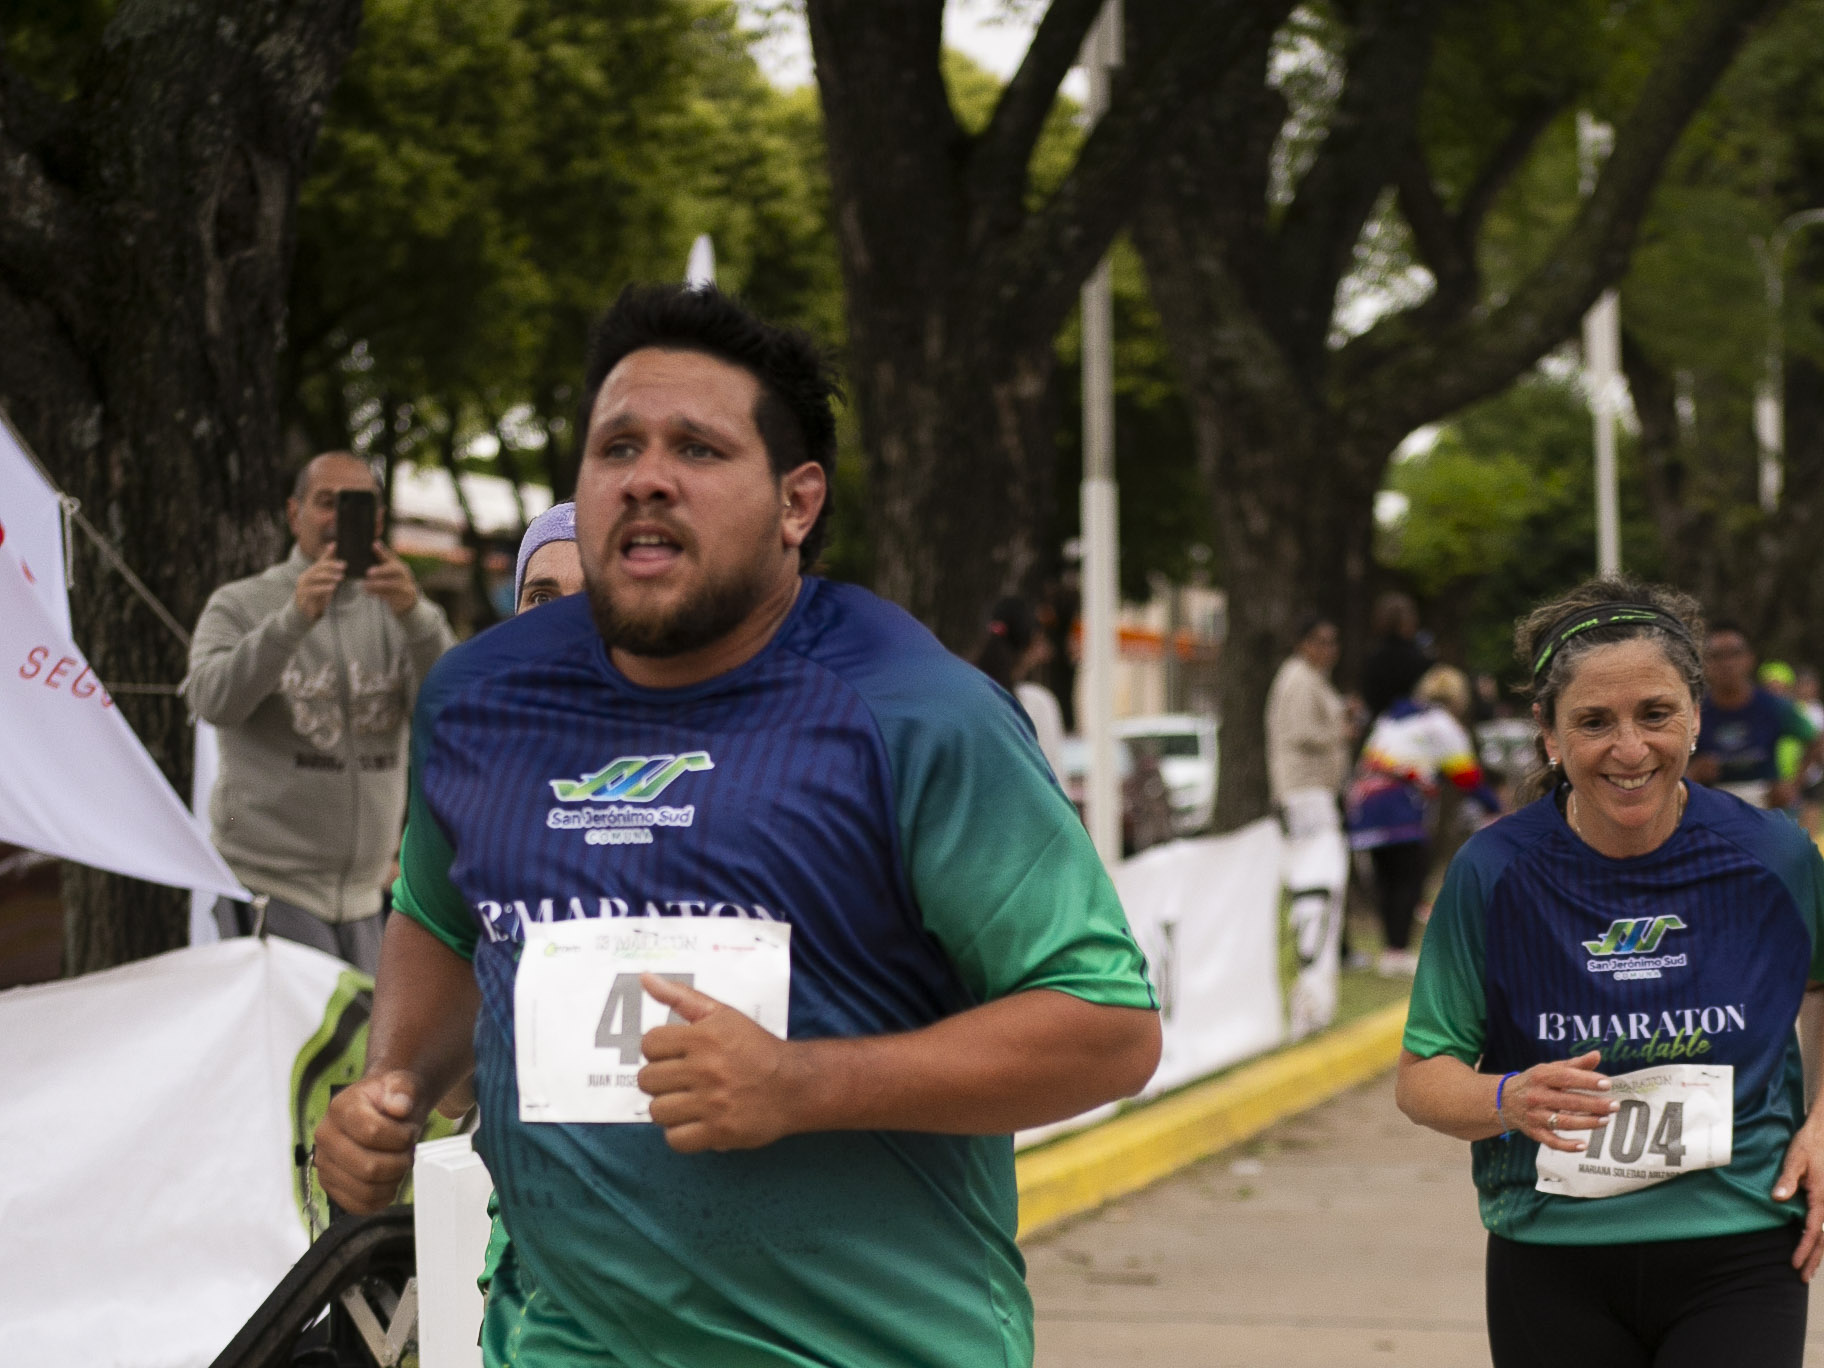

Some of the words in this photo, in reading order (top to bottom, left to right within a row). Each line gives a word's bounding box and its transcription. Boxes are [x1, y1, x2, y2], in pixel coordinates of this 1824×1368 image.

[549, 809, 581, 827] San
[583, 807, 655, 826] Jerónimo
[658, 807, 692, 825] Sud
[587, 830, 653, 843] COMUNA
[1588, 960, 1609, 970] San
[1611, 958, 1661, 969] Jerónimo
[1663, 956, 1685, 966] Sud
[1572, 1003, 1746, 1041] MARATON
[1578, 1163, 1611, 1176] MARIANA
